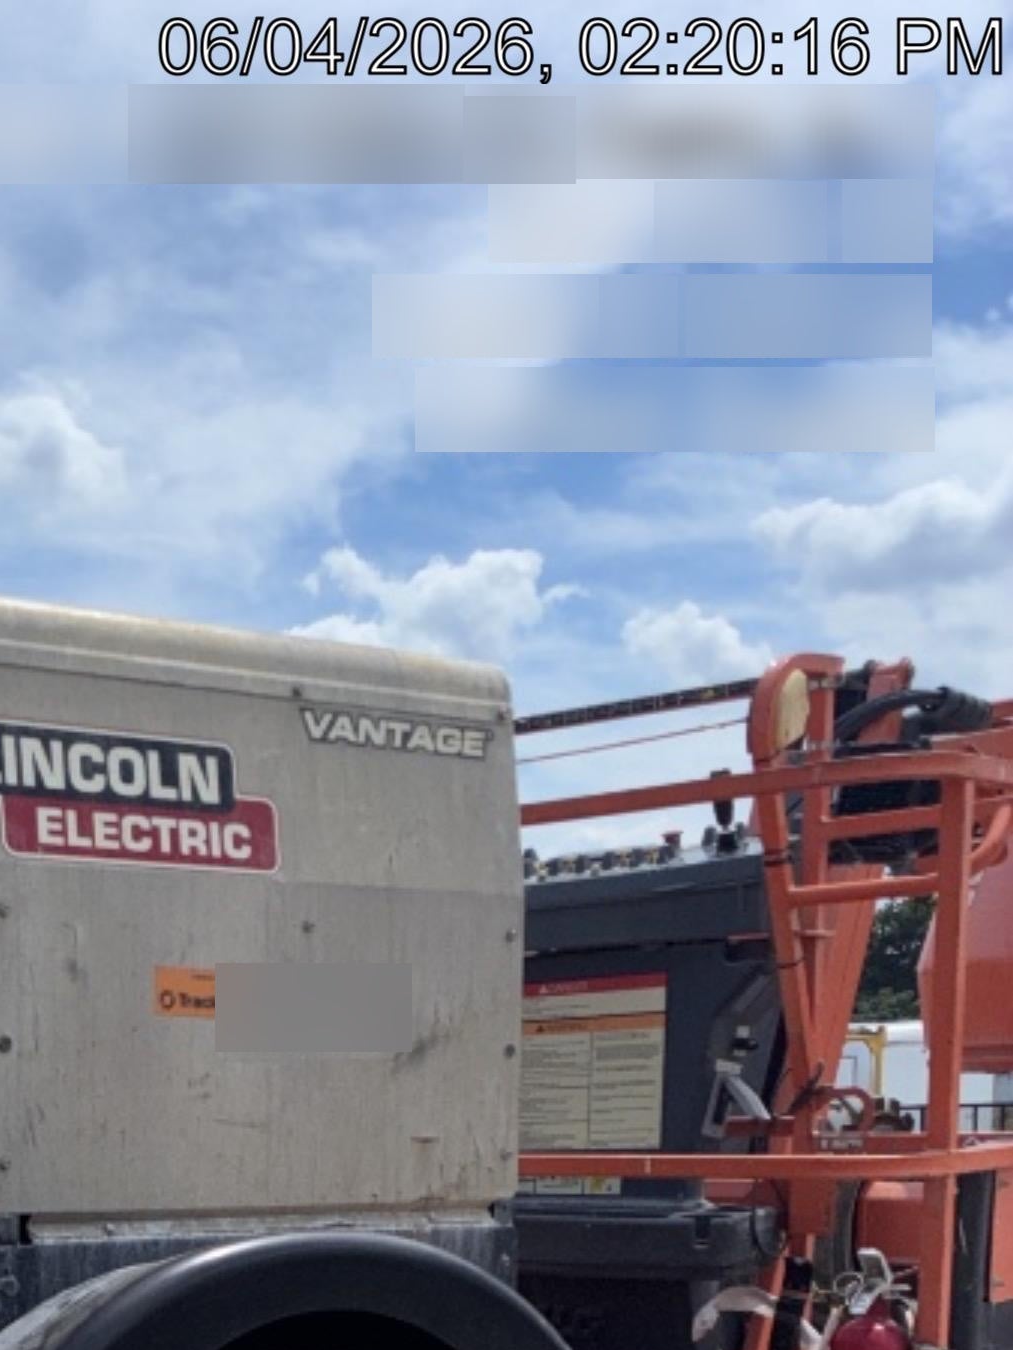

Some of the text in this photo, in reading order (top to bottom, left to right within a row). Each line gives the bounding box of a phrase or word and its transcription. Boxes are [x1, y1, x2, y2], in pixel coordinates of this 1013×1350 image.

[302, 708, 490, 759] VANTAGE
[35, 806, 253, 860] ELECTRIC
[178, 991, 216, 1009] Trac
